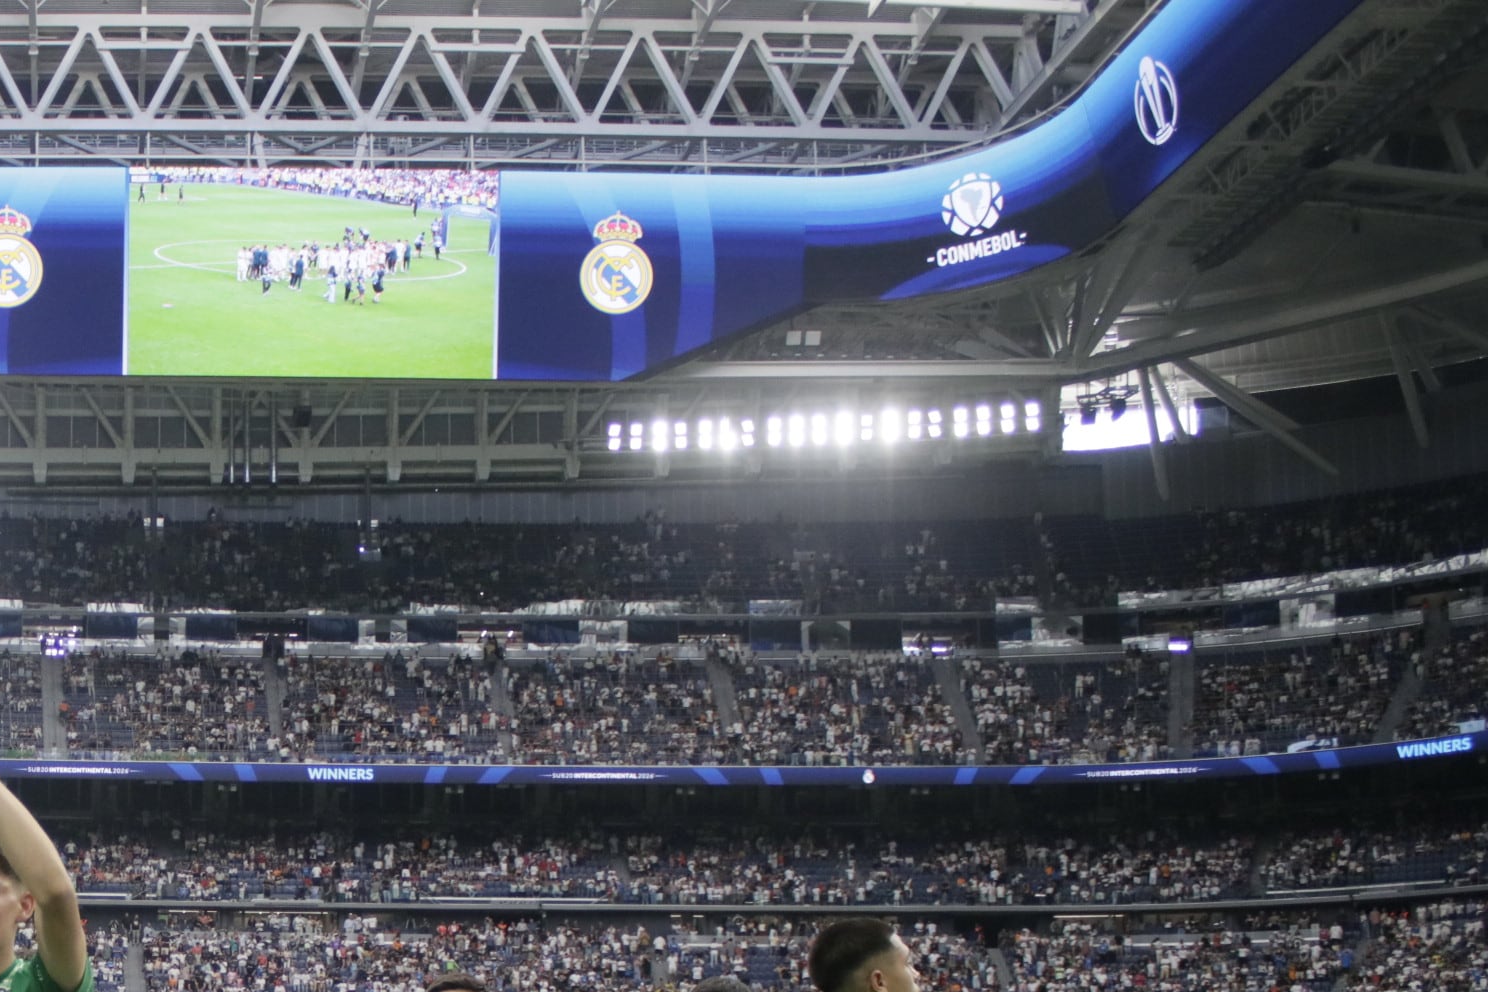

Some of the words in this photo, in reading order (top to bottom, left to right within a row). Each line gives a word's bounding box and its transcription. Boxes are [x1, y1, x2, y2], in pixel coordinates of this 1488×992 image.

[936, 229, 1022, 267] CONMEBOL
[1396, 738, 1473, 758] WINNERS
[307, 767, 374, 781] WINNERS
